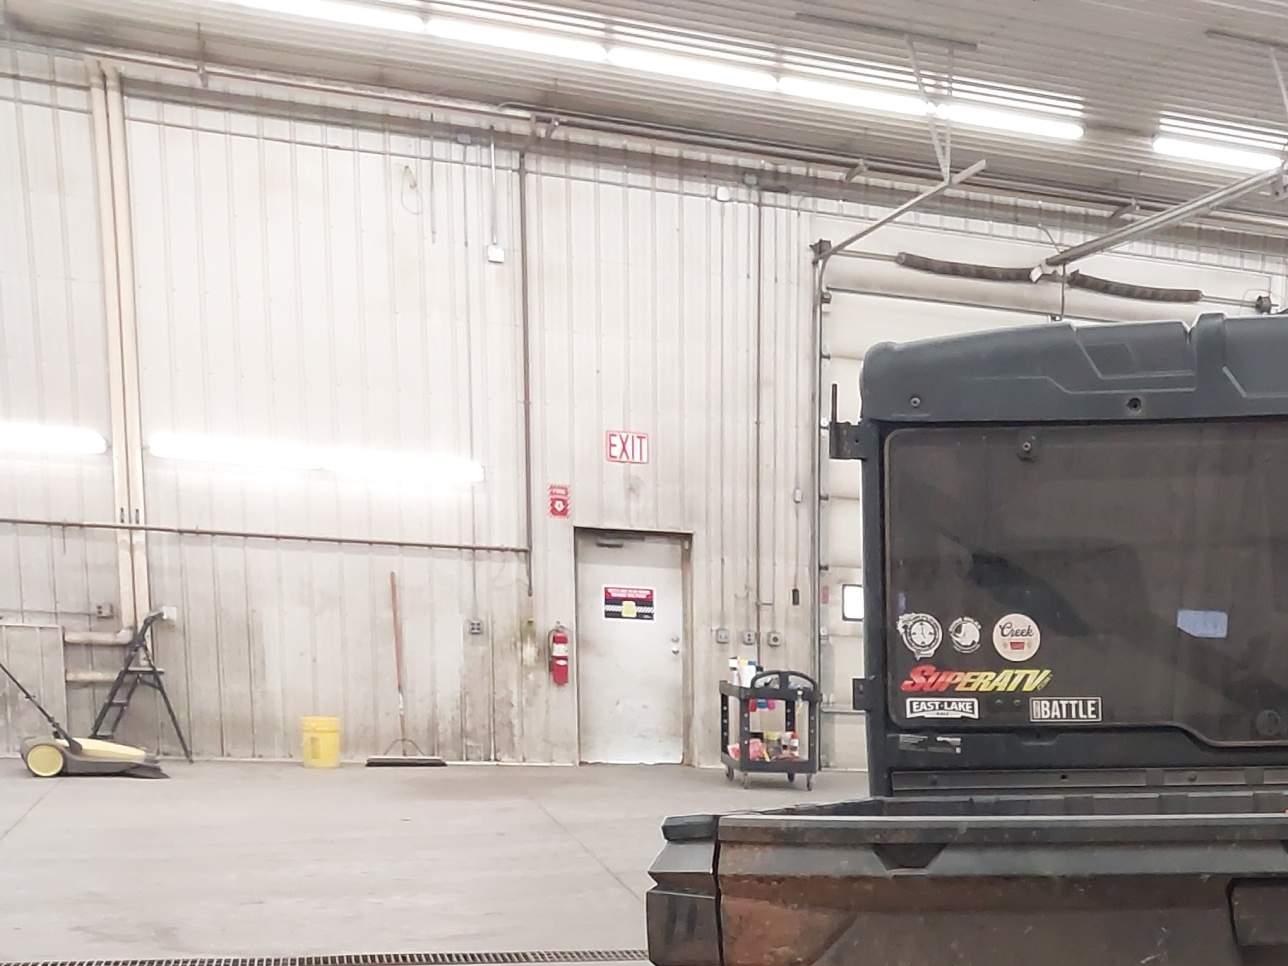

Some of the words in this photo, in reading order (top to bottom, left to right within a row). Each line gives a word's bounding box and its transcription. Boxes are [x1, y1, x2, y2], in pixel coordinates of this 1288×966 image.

[609, 433, 647, 461] EXIT
[1000, 621, 1034, 638] Creek
[1041, 699, 1098, 719] BATTLE
